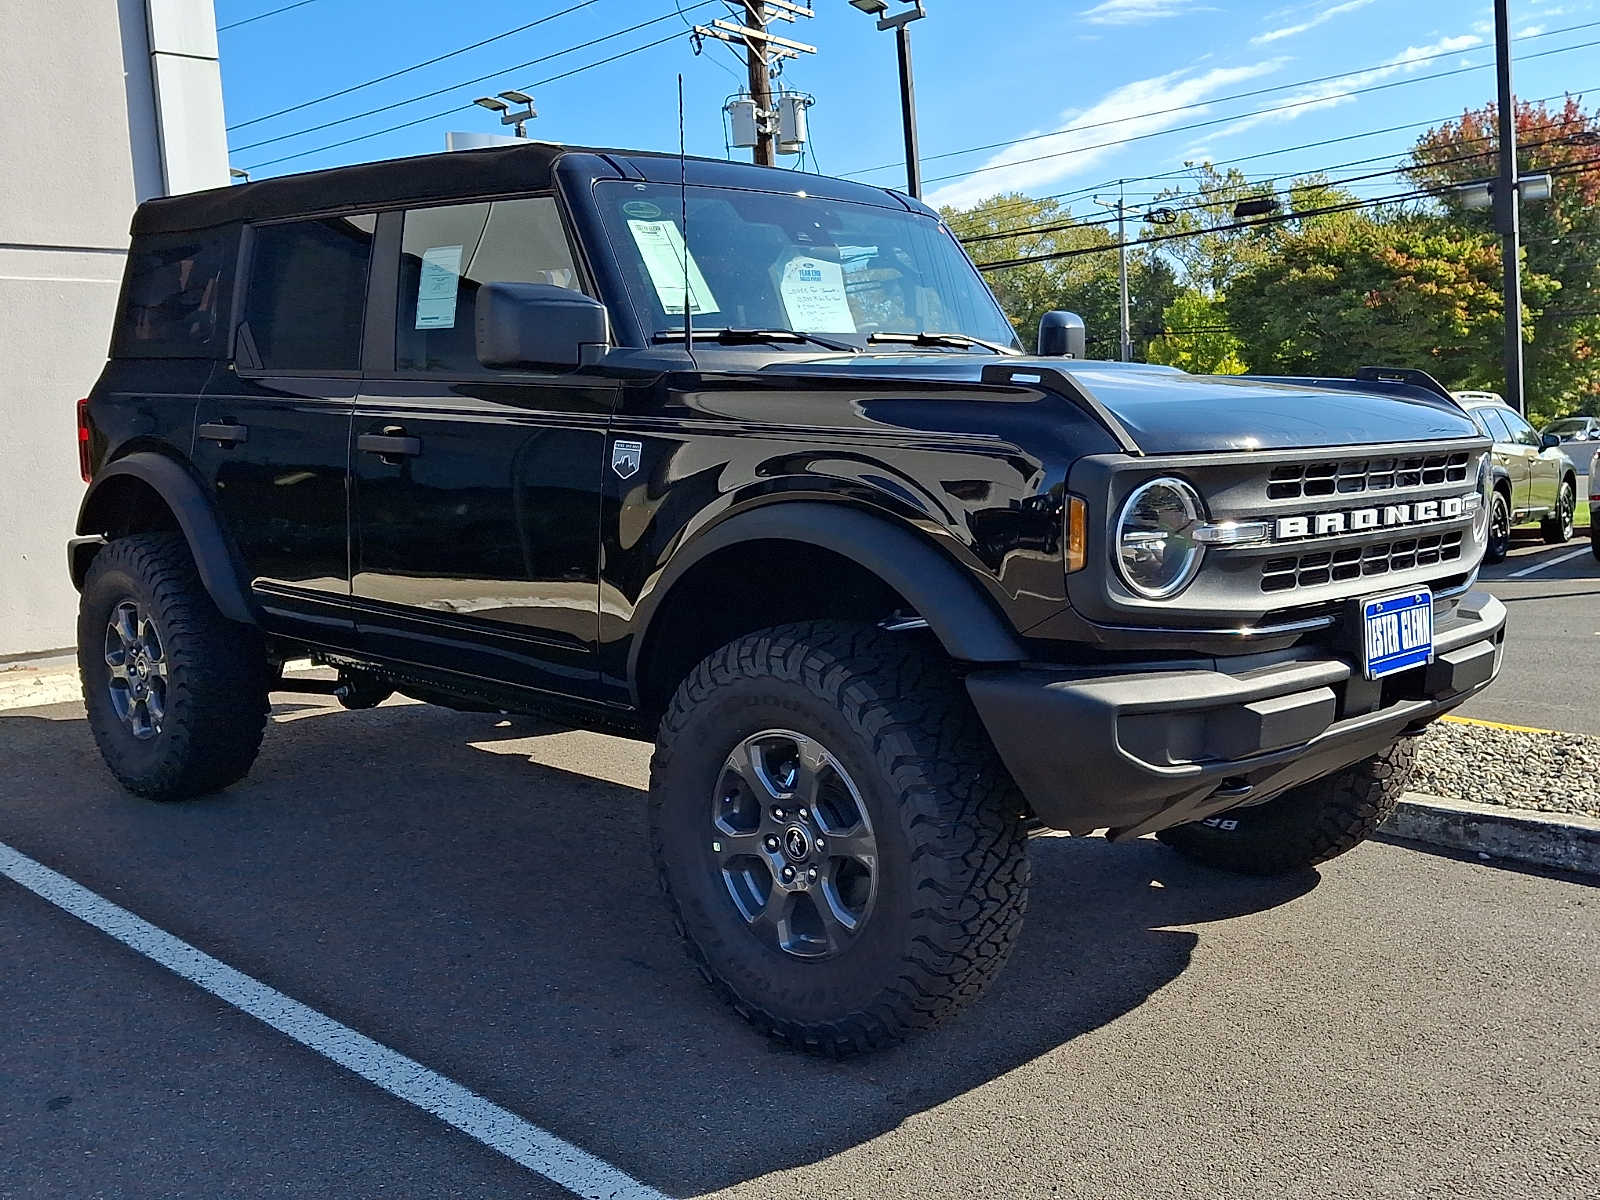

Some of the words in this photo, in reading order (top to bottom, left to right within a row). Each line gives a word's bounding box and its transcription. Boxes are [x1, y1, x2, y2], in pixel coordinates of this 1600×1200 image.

[1277, 498, 1462, 538] BRONCO
[1368, 614, 1400, 659] LESTER
[1401, 607, 1431, 649] GLENN
